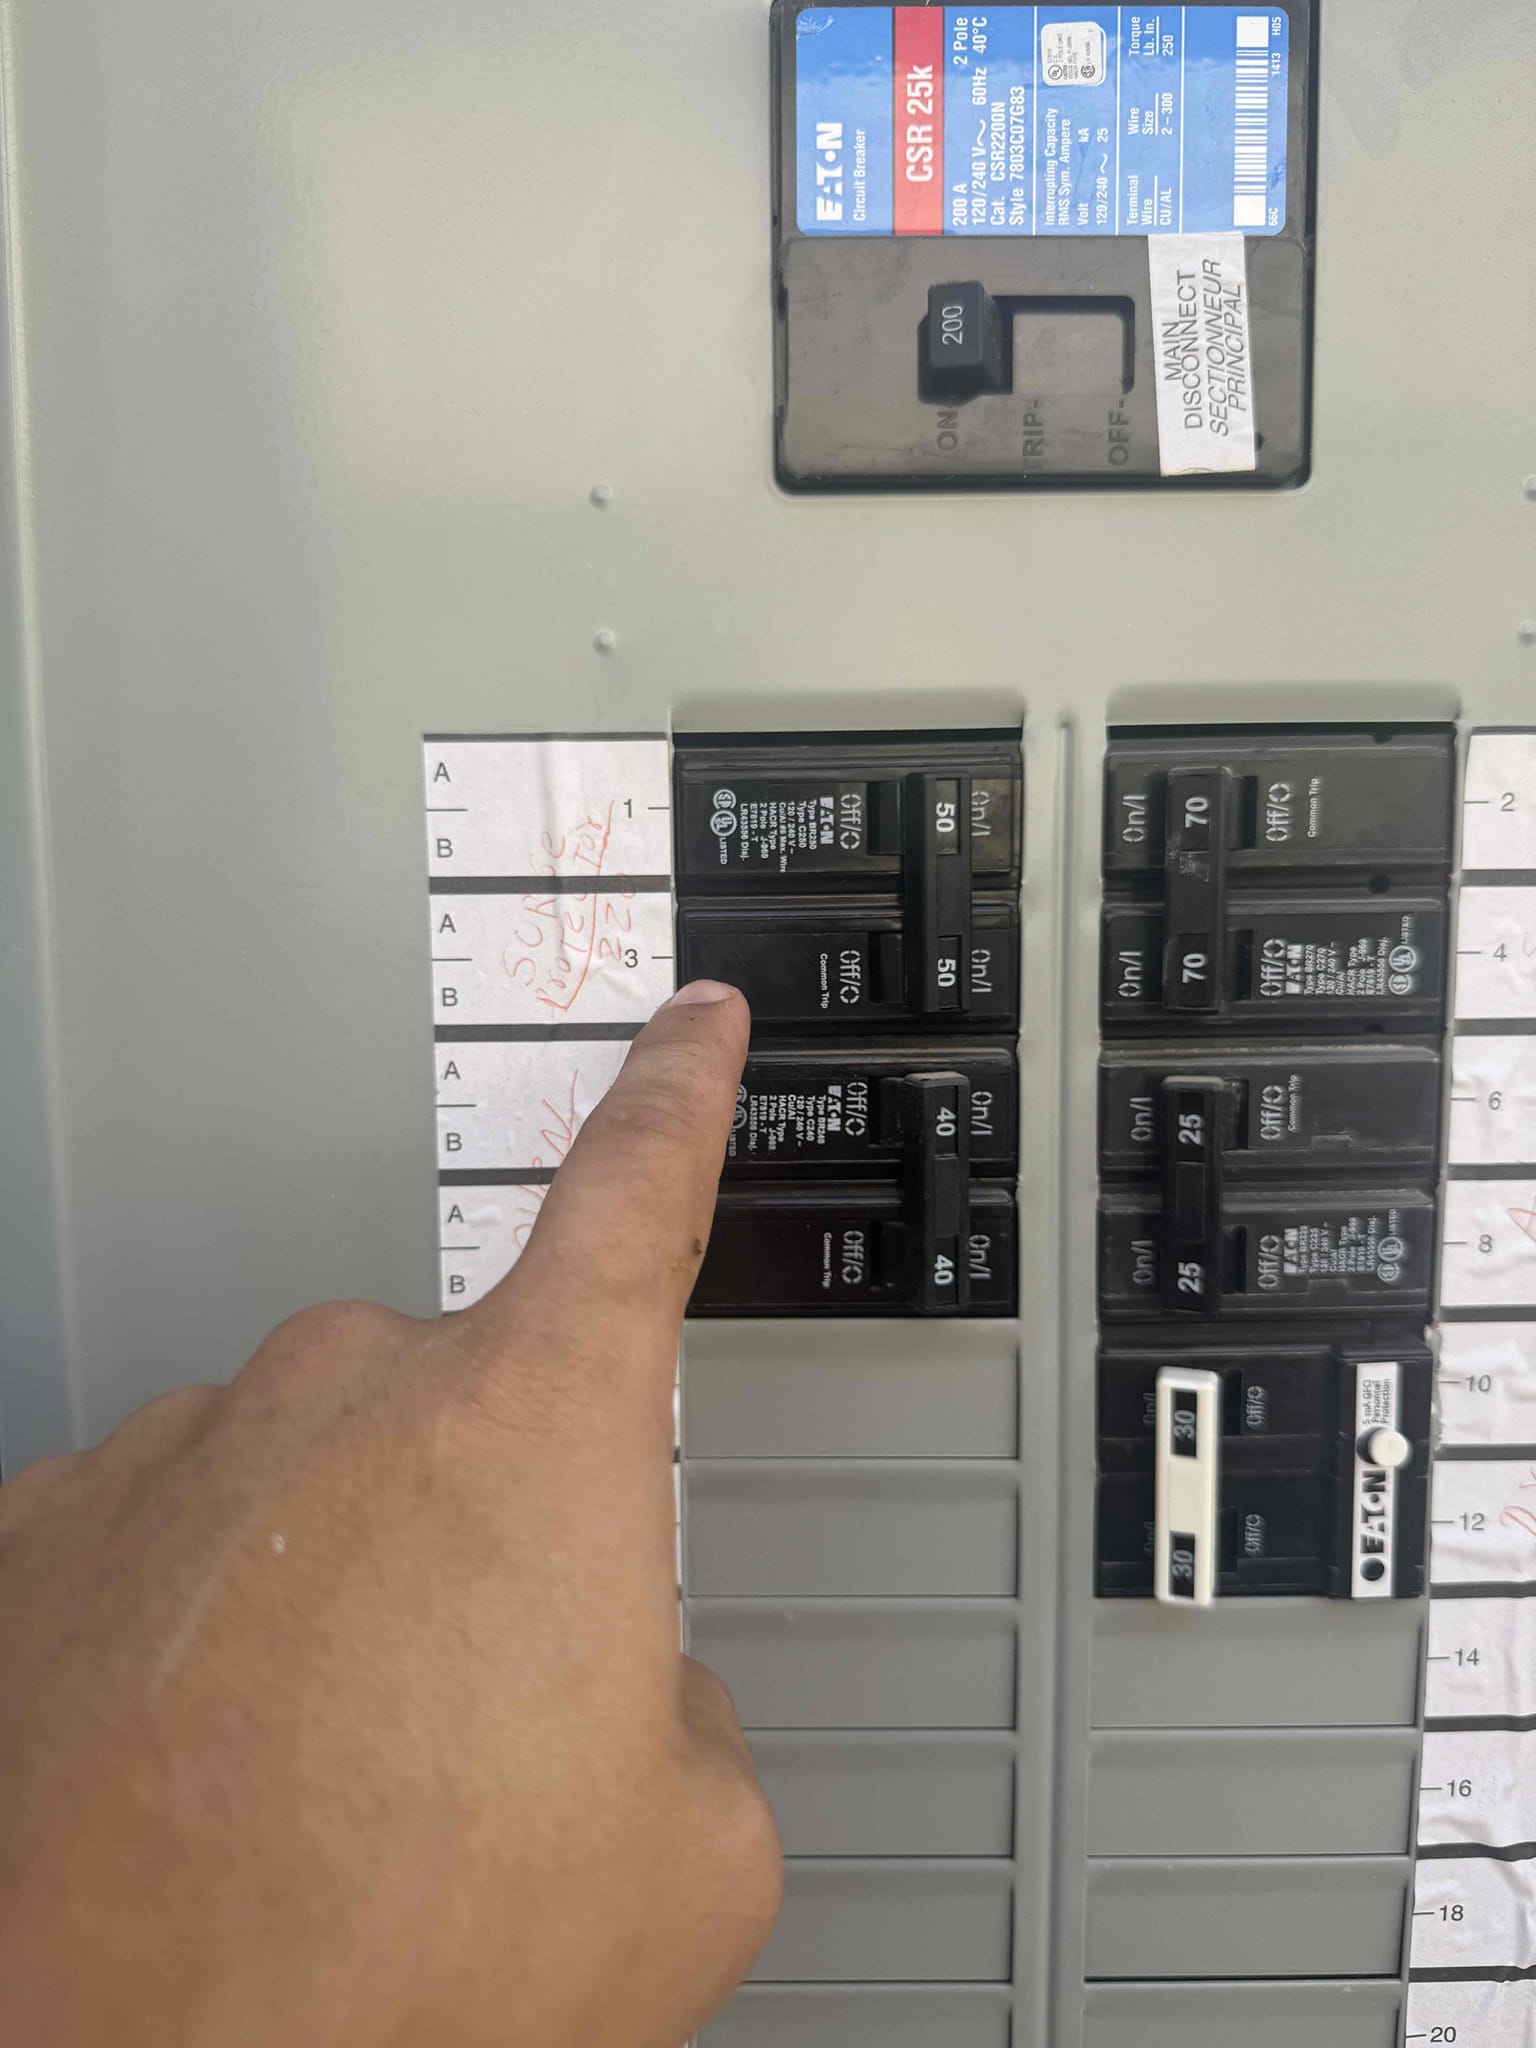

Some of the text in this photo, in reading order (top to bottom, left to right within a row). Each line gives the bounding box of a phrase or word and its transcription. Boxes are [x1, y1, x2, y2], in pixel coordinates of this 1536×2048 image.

[954, 17, 968, 65] 2 Pole
[973, 17, 987, 53] 40°C
[1129, 16, 1141, 56] Torque
[1144, 19, 1155, 55] Lb. In.
[1163, 35, 1173, 56] 250
[1272, 53, 1281, 75] 1413
[973, 67, 986, 105] 60Hz
[906, 65, 933, 182] CSR 25k
[1078, 128, 1088, 142] kA
[1098, 128, 1108, 142] 25
[1128, 107, 1139, 135] Wire
[1143, 111, 1154, 135] Size
[991, 102, 1005, 225] Cat. CSR2200N
[1010, 86, 1027, 225] Style 7803C07G83
[1044, 108, 1058, 226] Interrupting Capacity
[816, 122, 843, 221] EATON
[854, 129, 866, 221] Circuit Breaker
[1059, 119, 1072, 226] RMS Sym. Ampere
[953, 184, 967, 225] 200 A
[972, 162, 986, 225] 120/240
[1097, 177, 1108, 225] 120/240
[1127, 175, 1139, 226] Terminal
[1160, 188, 1172, 226] CU/AL
[1078, 203, 1088, 225] Volt
[1141, 198, 1153, 226] Wire
[942, 305, 963, 345] 200
[1163, 321, 1181, 381] MAIN
[1177, 269, 1202, 430] DISCONNECT
[1202, 259, 1229, 436] SECTIONNEUR
[1221, 283, 1246, 412] PRINCIPAL
[434, 762, 451, 782] A
[623, 799, 633, 818] 1
[797, 802, 806, 823] Type
[808, 800, 816, 820] Type
[1185, 797, 1209, 828] 70
[1307, 777, 1319, 838] Common Trip
[1501, 792, 1515, 812] 2
[935, 803, 955, 833] 50
[437, 839, 453, 858] B
[719, 837, 727, 864] LISTED
[768, 830, 777, 849] Type
[440, 914, 456, 933] A
[624, 950, 638, 968] 3
[1492, 942, 1507, 962] 4
[820, 953, 830, 1009] Common Trip
[937, 958, 956, 987] 50
[1182, 954, 1206, 983] 70
[442, 988, 458, 1006] B
[1304, 975, 1313, 995] Type
[1316, 973, 1325, 994] Type
[444, 1062, 460, 1080] A
[806, 1096, 815, 1117] Type
[817, 1095, 825, 1115] Type
[1489, 1092, 1501, 1110] 6
[777, 1122, 785, 1142] Type
[935, 1107, 956, 1136] 40
[1178, 1114, 1201, 1145] 25
[447, 1133, 462, 1151] B
[448, 1205, 464, 1223] A
[1478, 1234, 1493, 1253] 8
[822, 1232, 832, 1289] Common Trip
[934, 1254, 954, 1285] 40
[450, 1275, 466, 1293] B
[1178, 1262, 1200, 1294] 25
[1466, 1376, 1492, 1392] 10
[1372, 1380, 1380, 1423] Personnel
[1381, 1379, 1390, 1424] Protection
[1173, 1409, 1195, 1438] 30
[1360, 1471, 1386, 1554] EATON
[1459, 1514, 1484, 1531] 12
[1172, 1549, 1194, 1579] 30
[1453, 1648, 1480, 1666] 14
[1446, 1780, 1472, 1797] 16
[1439, 1905, 1464, 1921] 18
[1430, 2026, 1457, 2044] 20
